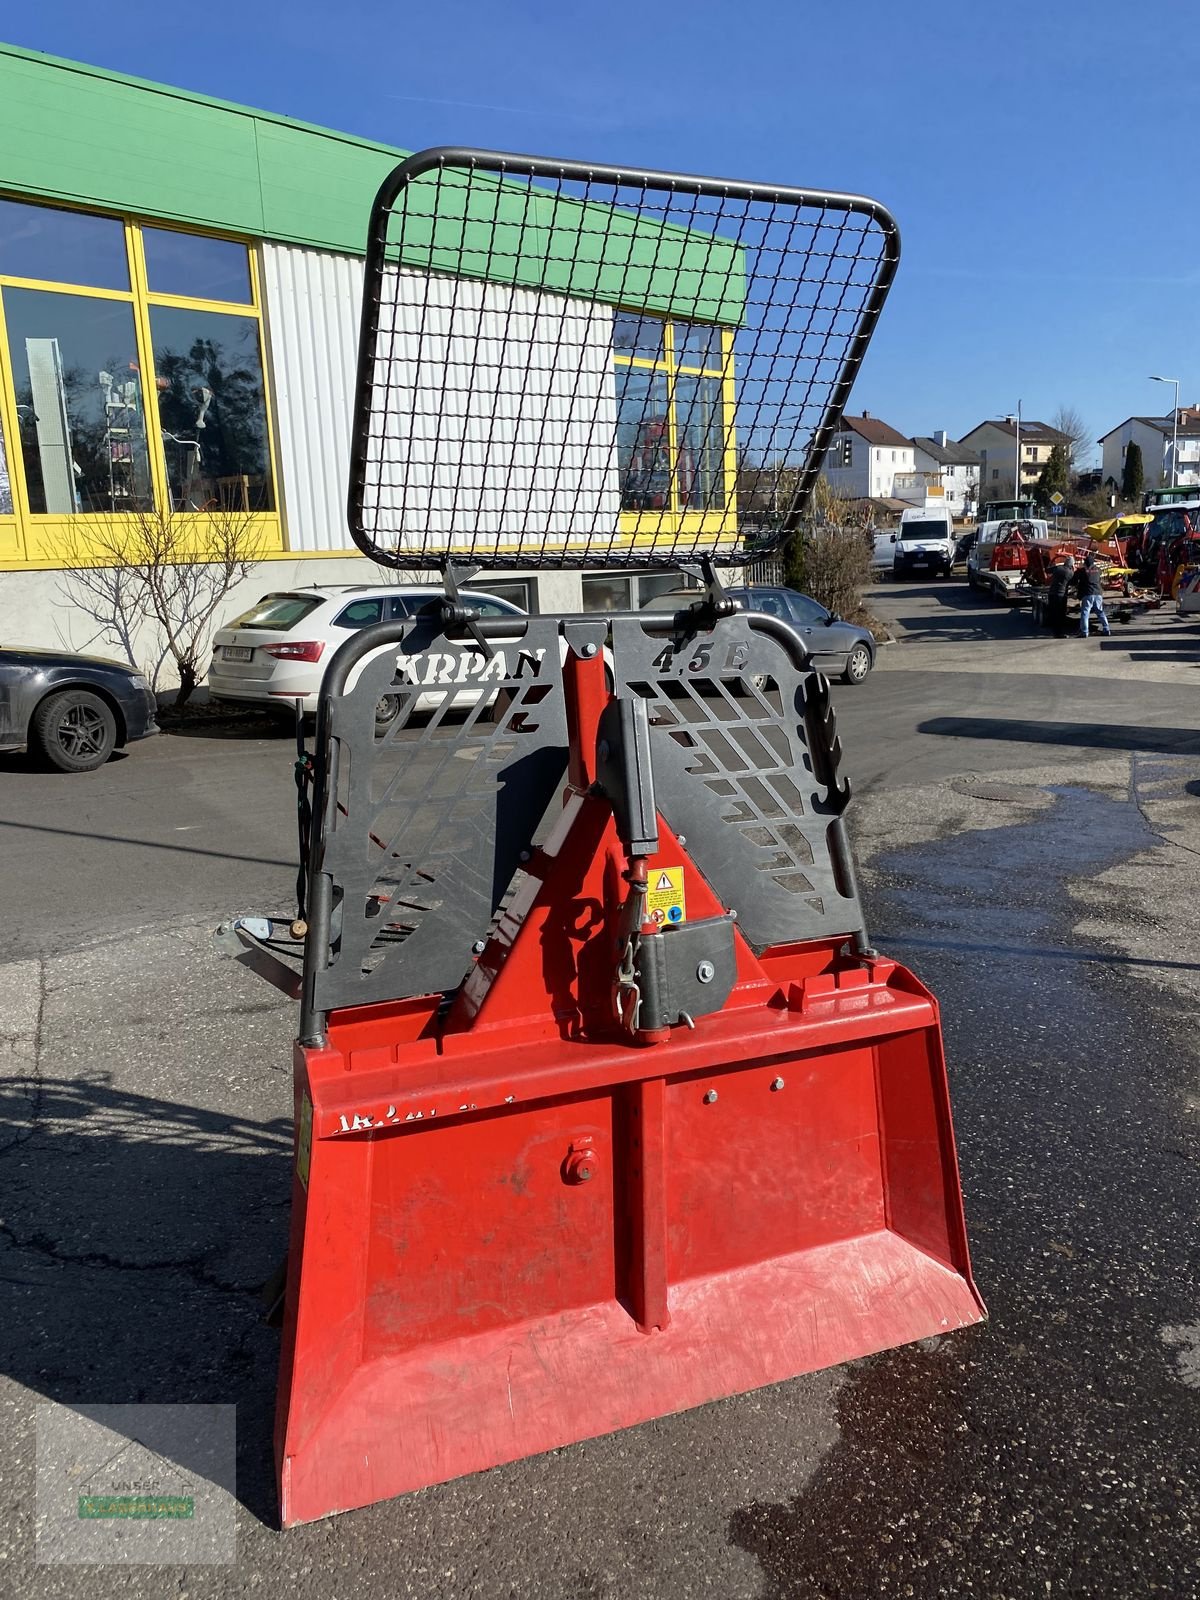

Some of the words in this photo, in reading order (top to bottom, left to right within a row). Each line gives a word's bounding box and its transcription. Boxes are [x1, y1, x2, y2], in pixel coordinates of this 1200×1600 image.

[390, 649, 546, 686] KRPAN
[652, 642, 715, 676] 4,5
[722, 641, 750, 671] E
